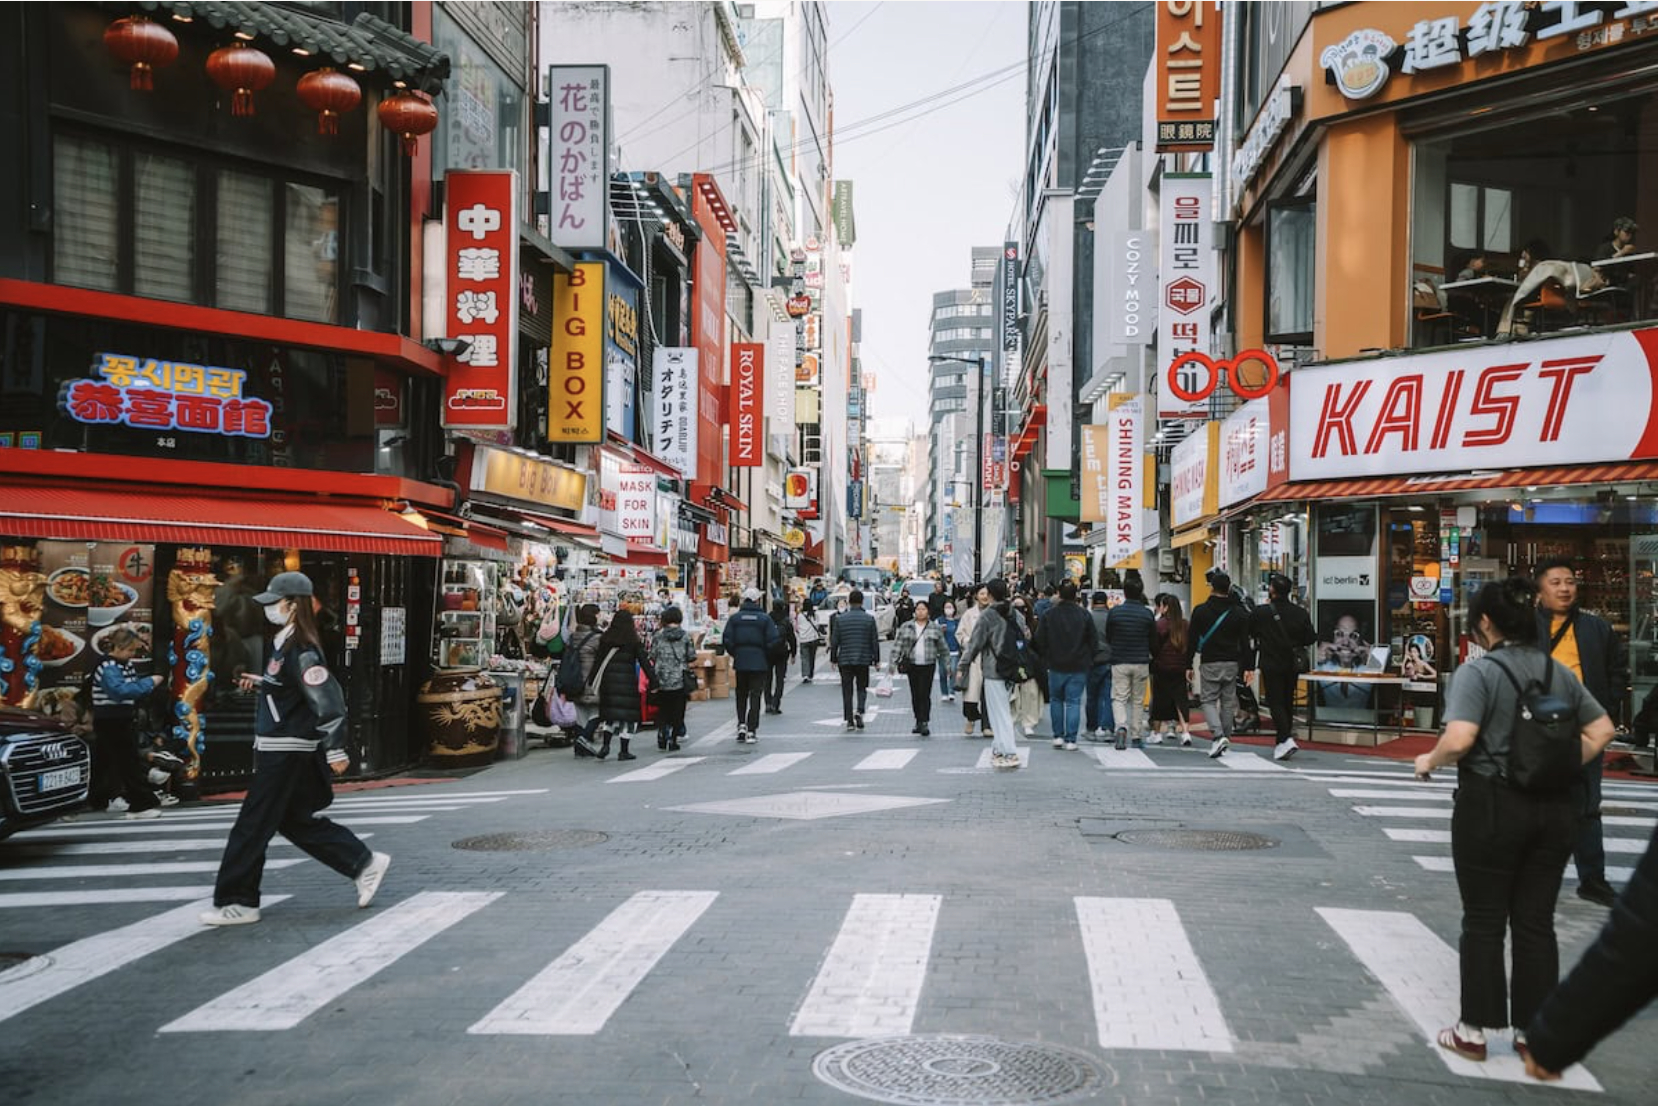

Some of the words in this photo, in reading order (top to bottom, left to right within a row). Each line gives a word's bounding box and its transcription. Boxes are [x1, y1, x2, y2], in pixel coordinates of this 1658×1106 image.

[1160, 123, 1213, 140] 眼鏡院
[558, 82, 588, 230] 花のかばん
[456, 203, 502, 367] 中華料理
[1007, 261, 1015, 287] HOTEL
[1126, 238, 1141, 286] COZY
[564, 268, 586, 336] BIG
[1005, 288, 1016, 346] SKYPARK
[1126, 290, 1140, 337] MOOD
[564, 352, 585, 420] BOX
[739, 349, 754, 412] ROYAL
[71, 382, 270, 435] 恭喜面館
[1311, 355, 1605, 458] KAIST
[739, 413, 753, 460] SKIN
[1118, 418, 1133, 489] SHINING
[619, 480, 652, 493] MASK
[623, 499, 648, 511] FOR
[622, 518, 650, 530] SKIN
[1117, 495, 1132, 543] MASK
[126, 551, 149, 578] 牛
